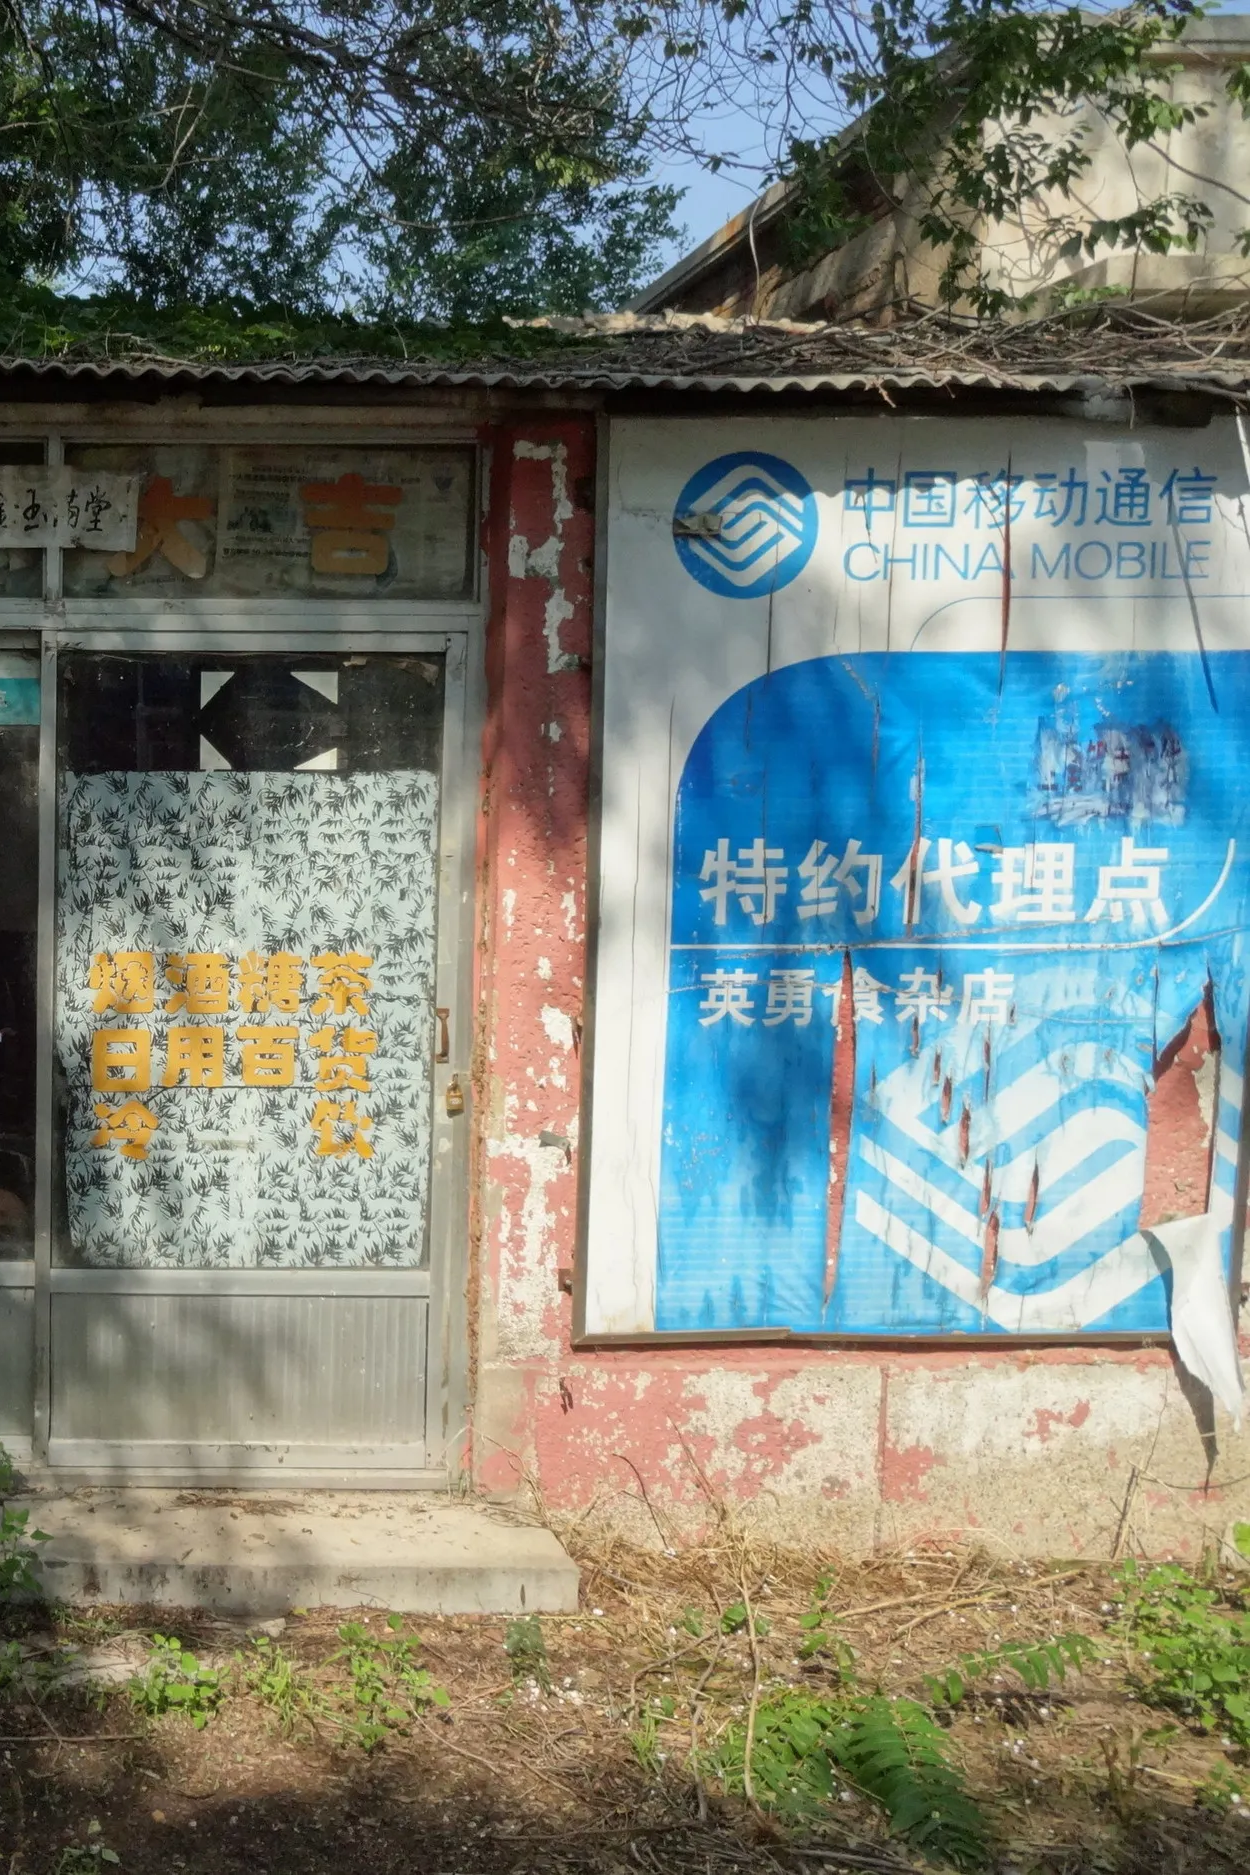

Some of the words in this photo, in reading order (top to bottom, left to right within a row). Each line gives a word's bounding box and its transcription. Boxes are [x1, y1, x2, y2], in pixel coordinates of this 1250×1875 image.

[843, 466, 1217, 530] 中国移动通信
[842, 542, 1015, 581] CHINA
[1029, 540, 1210, 580] MOBILE
[699, 838, 1171, 927] 特约代理点
[88, 950, 374, 1015] 烟酒糖茶
[699, 967, 1015, 1028] 英勇食杂店
[91, 1025, 377, 1092] 日用百货
